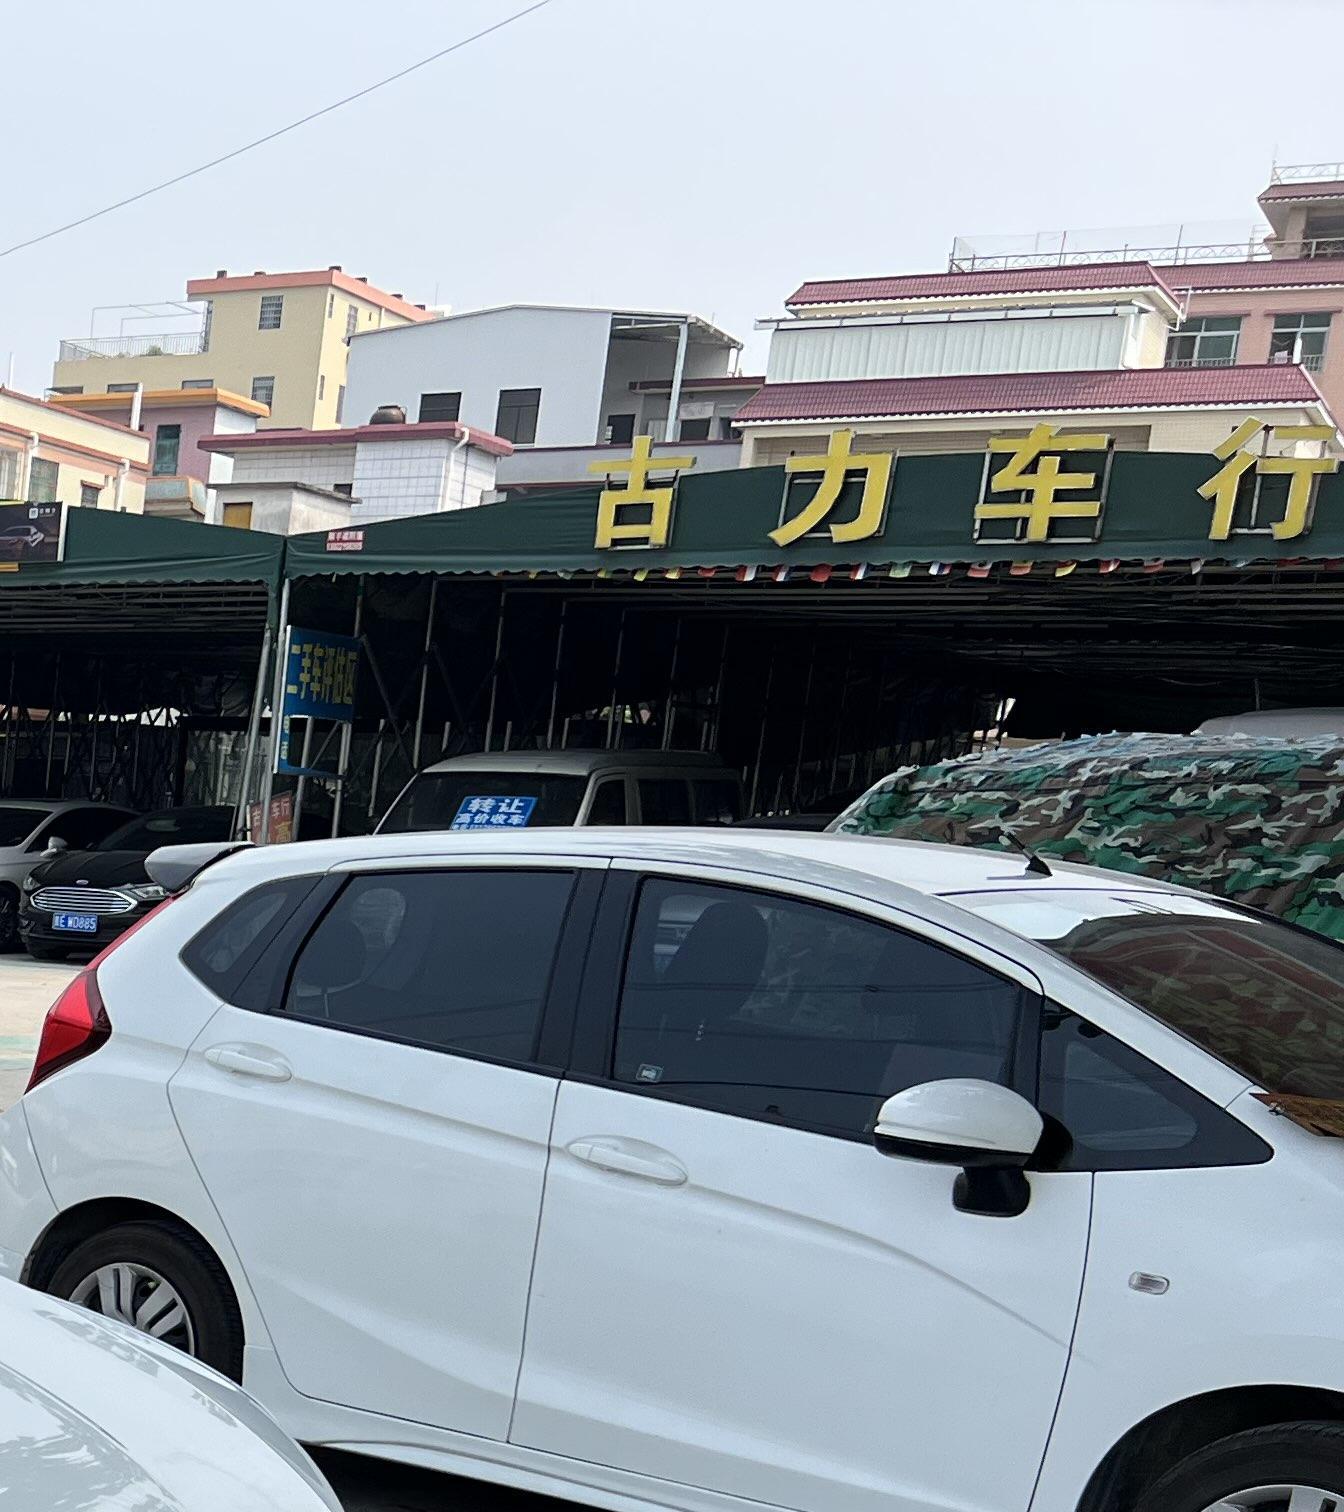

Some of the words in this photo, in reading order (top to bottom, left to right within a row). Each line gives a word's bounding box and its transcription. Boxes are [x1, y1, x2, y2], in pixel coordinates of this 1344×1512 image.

[586, 415, 1341, 549] 古力车行
[467, 798, 525, 813] 转让
